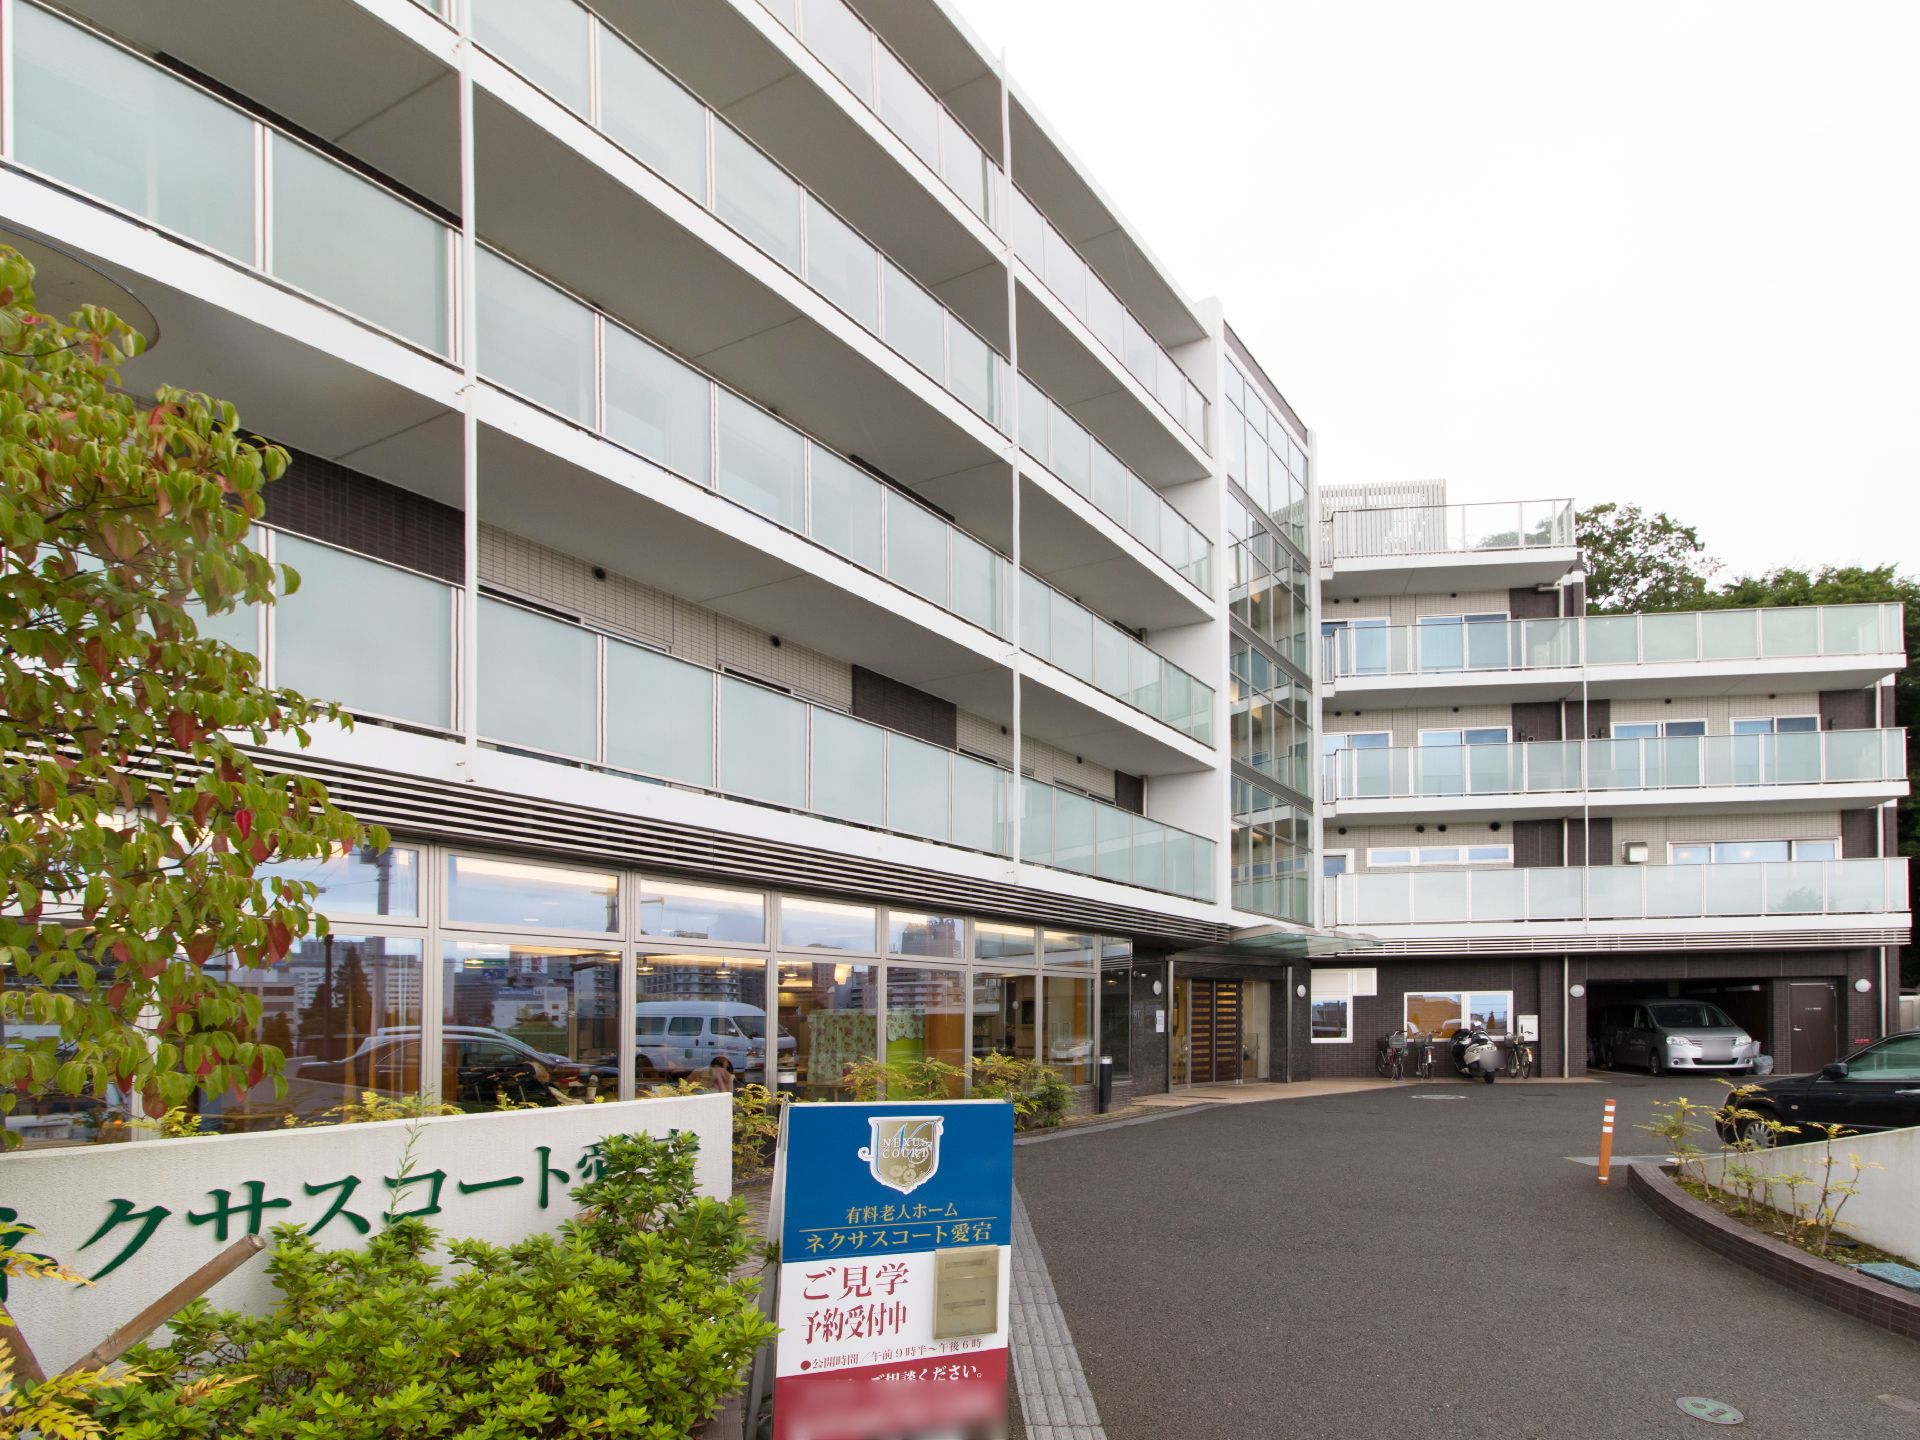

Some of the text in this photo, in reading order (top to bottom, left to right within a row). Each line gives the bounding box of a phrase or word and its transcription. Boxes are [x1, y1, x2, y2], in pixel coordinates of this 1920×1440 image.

[883, 1137, 929, 1147] NEXUS
[846, 1202, 958, 1224] 有料老人ホーム
[805, 1221, 992, 1253] ネクサスコート愛宕
[803, 1262, 909, 1301] ご見学
[801, 1301, 907, 1344] 予約受付中
